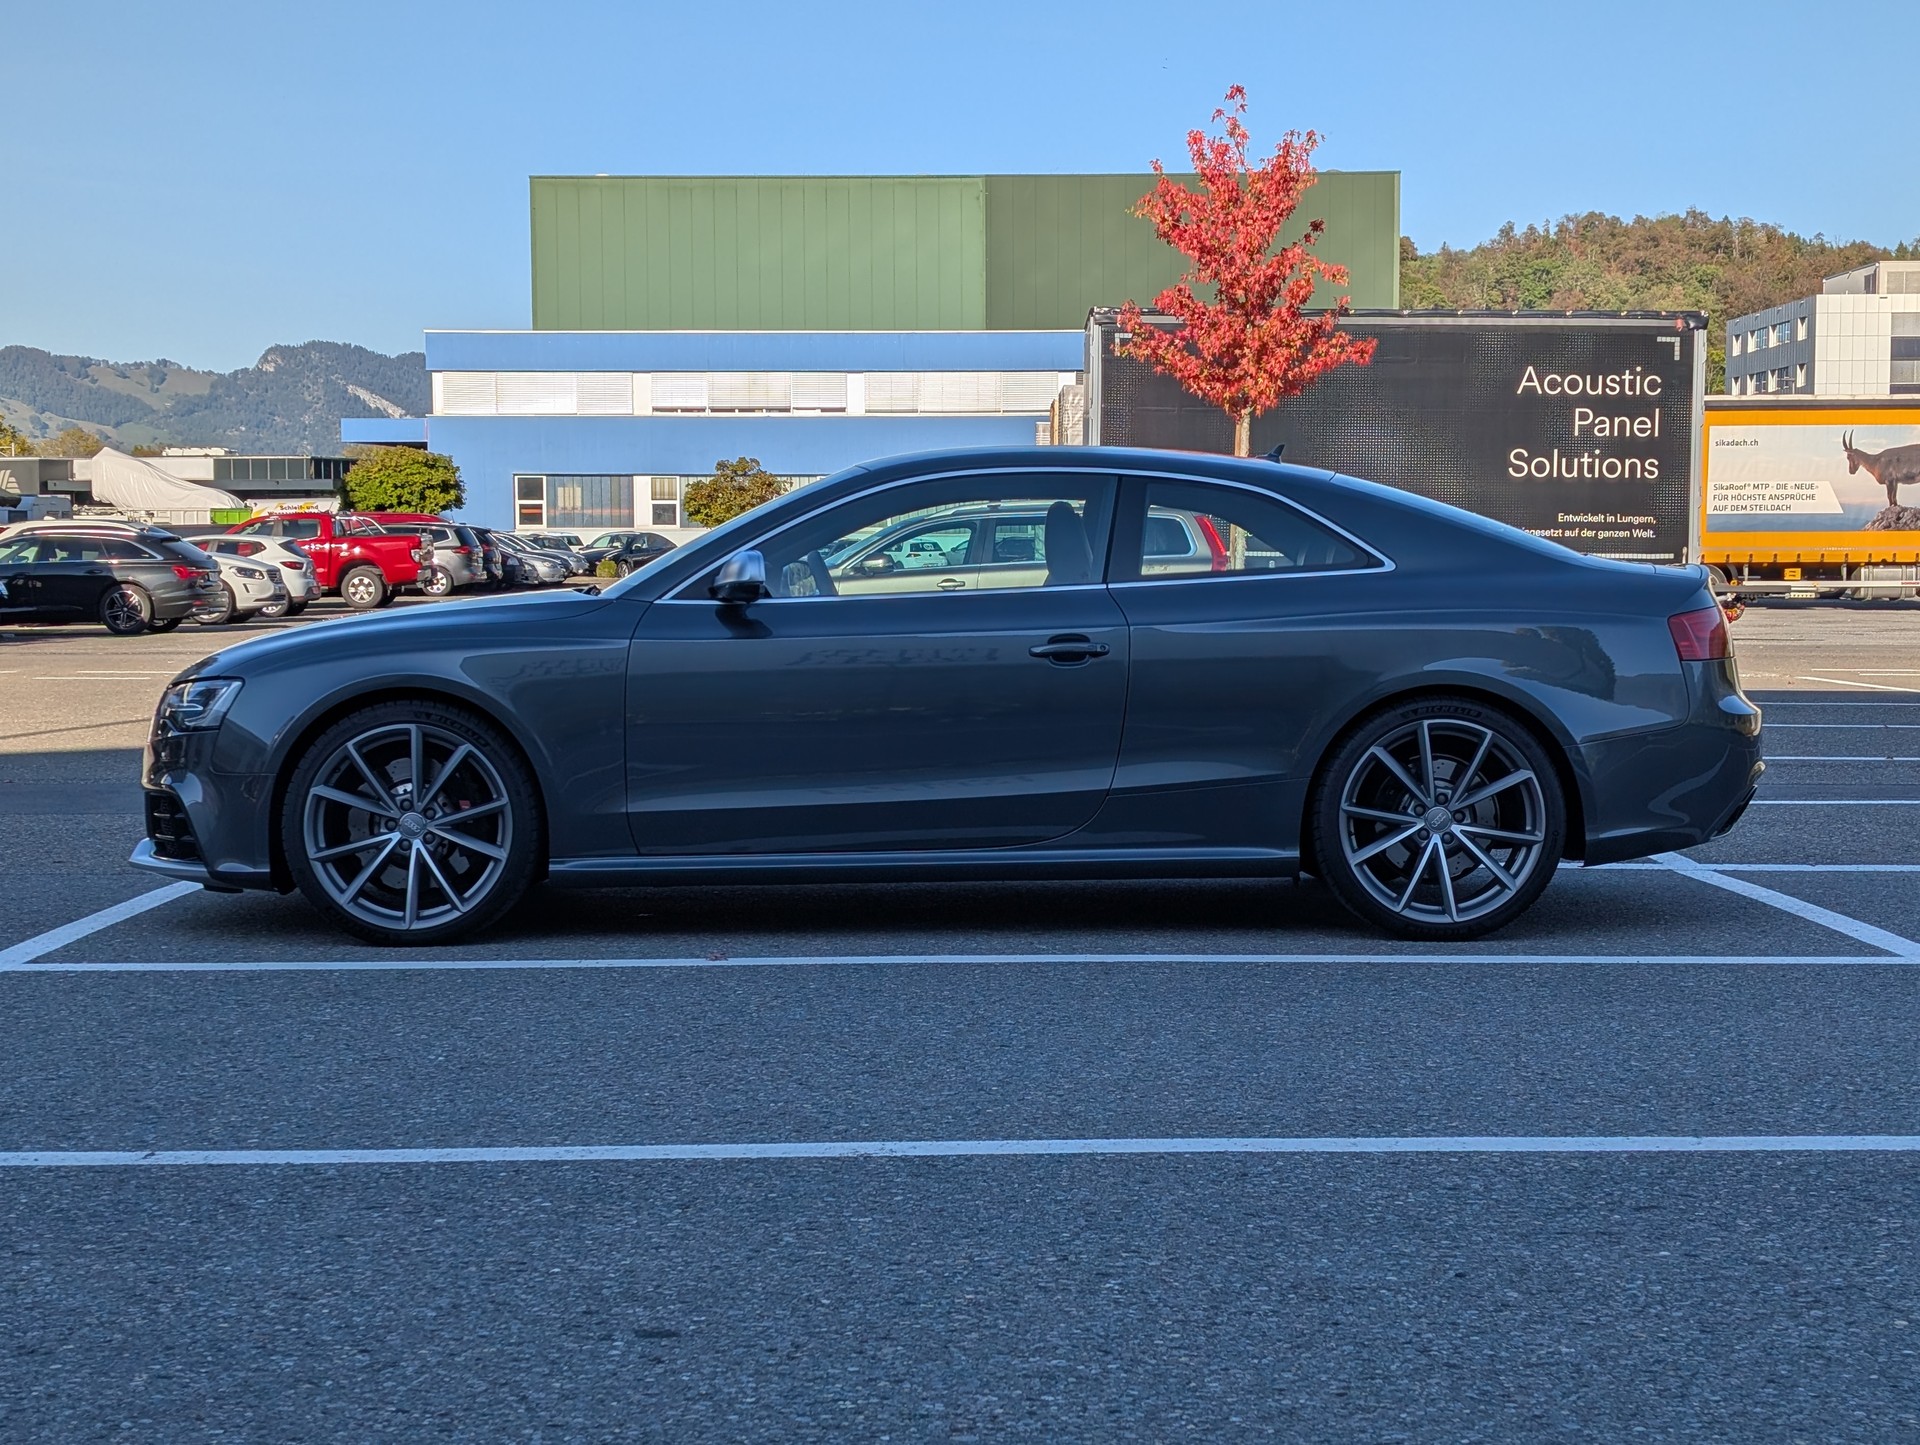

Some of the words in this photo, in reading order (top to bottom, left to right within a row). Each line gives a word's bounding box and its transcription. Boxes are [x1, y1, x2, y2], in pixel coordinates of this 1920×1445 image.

[1516, 365, 1662, 396] Acoustic
[1574, 407, 1660, 438] Panel
[1715, 439, 1759, 447] sikadach.ch
[1508, 448, 1659, 479] Solutions
[1752, 483, 1770, 491] MTP
[1713, 493, 1729, 501] FÜR
[1730, 493, 1766, 501] HÖCHSTE
[1768, 493, 1816, 501] ANSPRÜCHE
[1712, 504, 1729, 512] AUF
[1730, 504, 1748, 512] DEM
[1749, 504, 1792, 512] STEILDACH
[1558, 512, 1605, 523] Entwickelt
[1606, 513, 1615, 523] in
[1617, 513, 1657, 525] Lungern,
[1564, 528, 1579, 538] auf
[1581, 528, 1596, 538] der
[1598, 530, 1630, 540] ganzen
[1632, 529, 1657, 539] Welt.
[1416, 705, 1480, 718] MICHELIN
